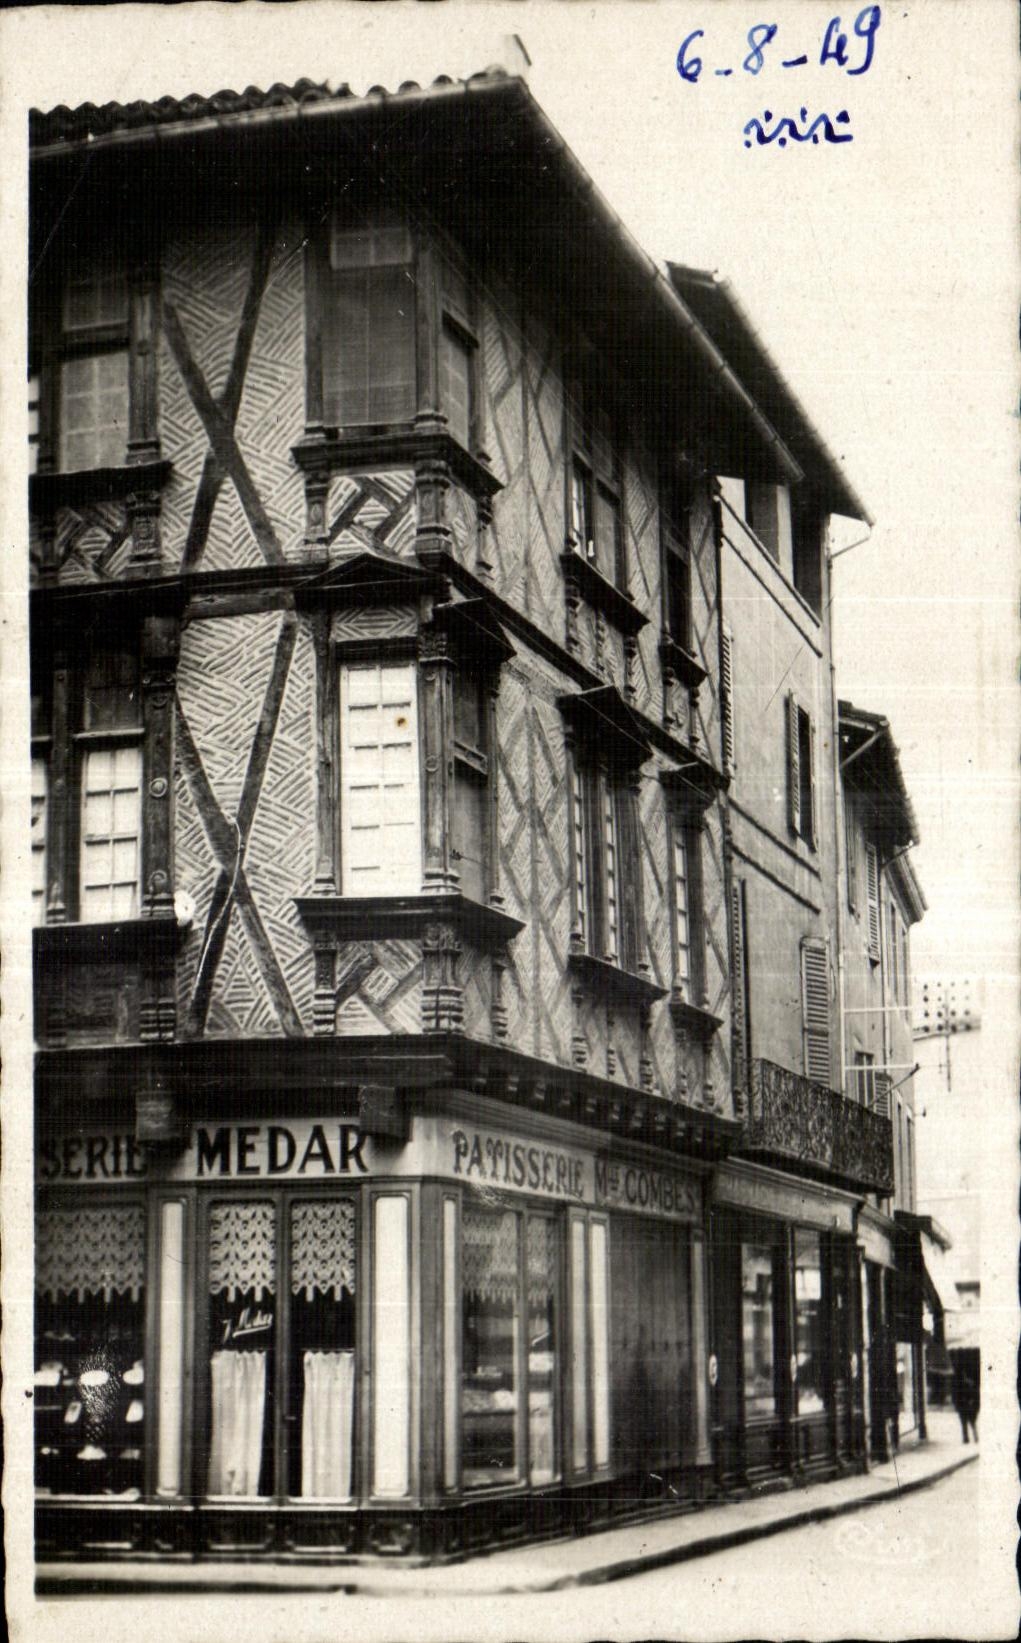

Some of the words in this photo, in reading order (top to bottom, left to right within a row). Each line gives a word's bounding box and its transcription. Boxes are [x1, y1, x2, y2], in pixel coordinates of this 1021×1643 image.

[196, 1124, 369, 1177] MEDAR
[453, 1129, 584, 1198] PATISSERIE
[625, 1169, 695, 1214] COMBES
